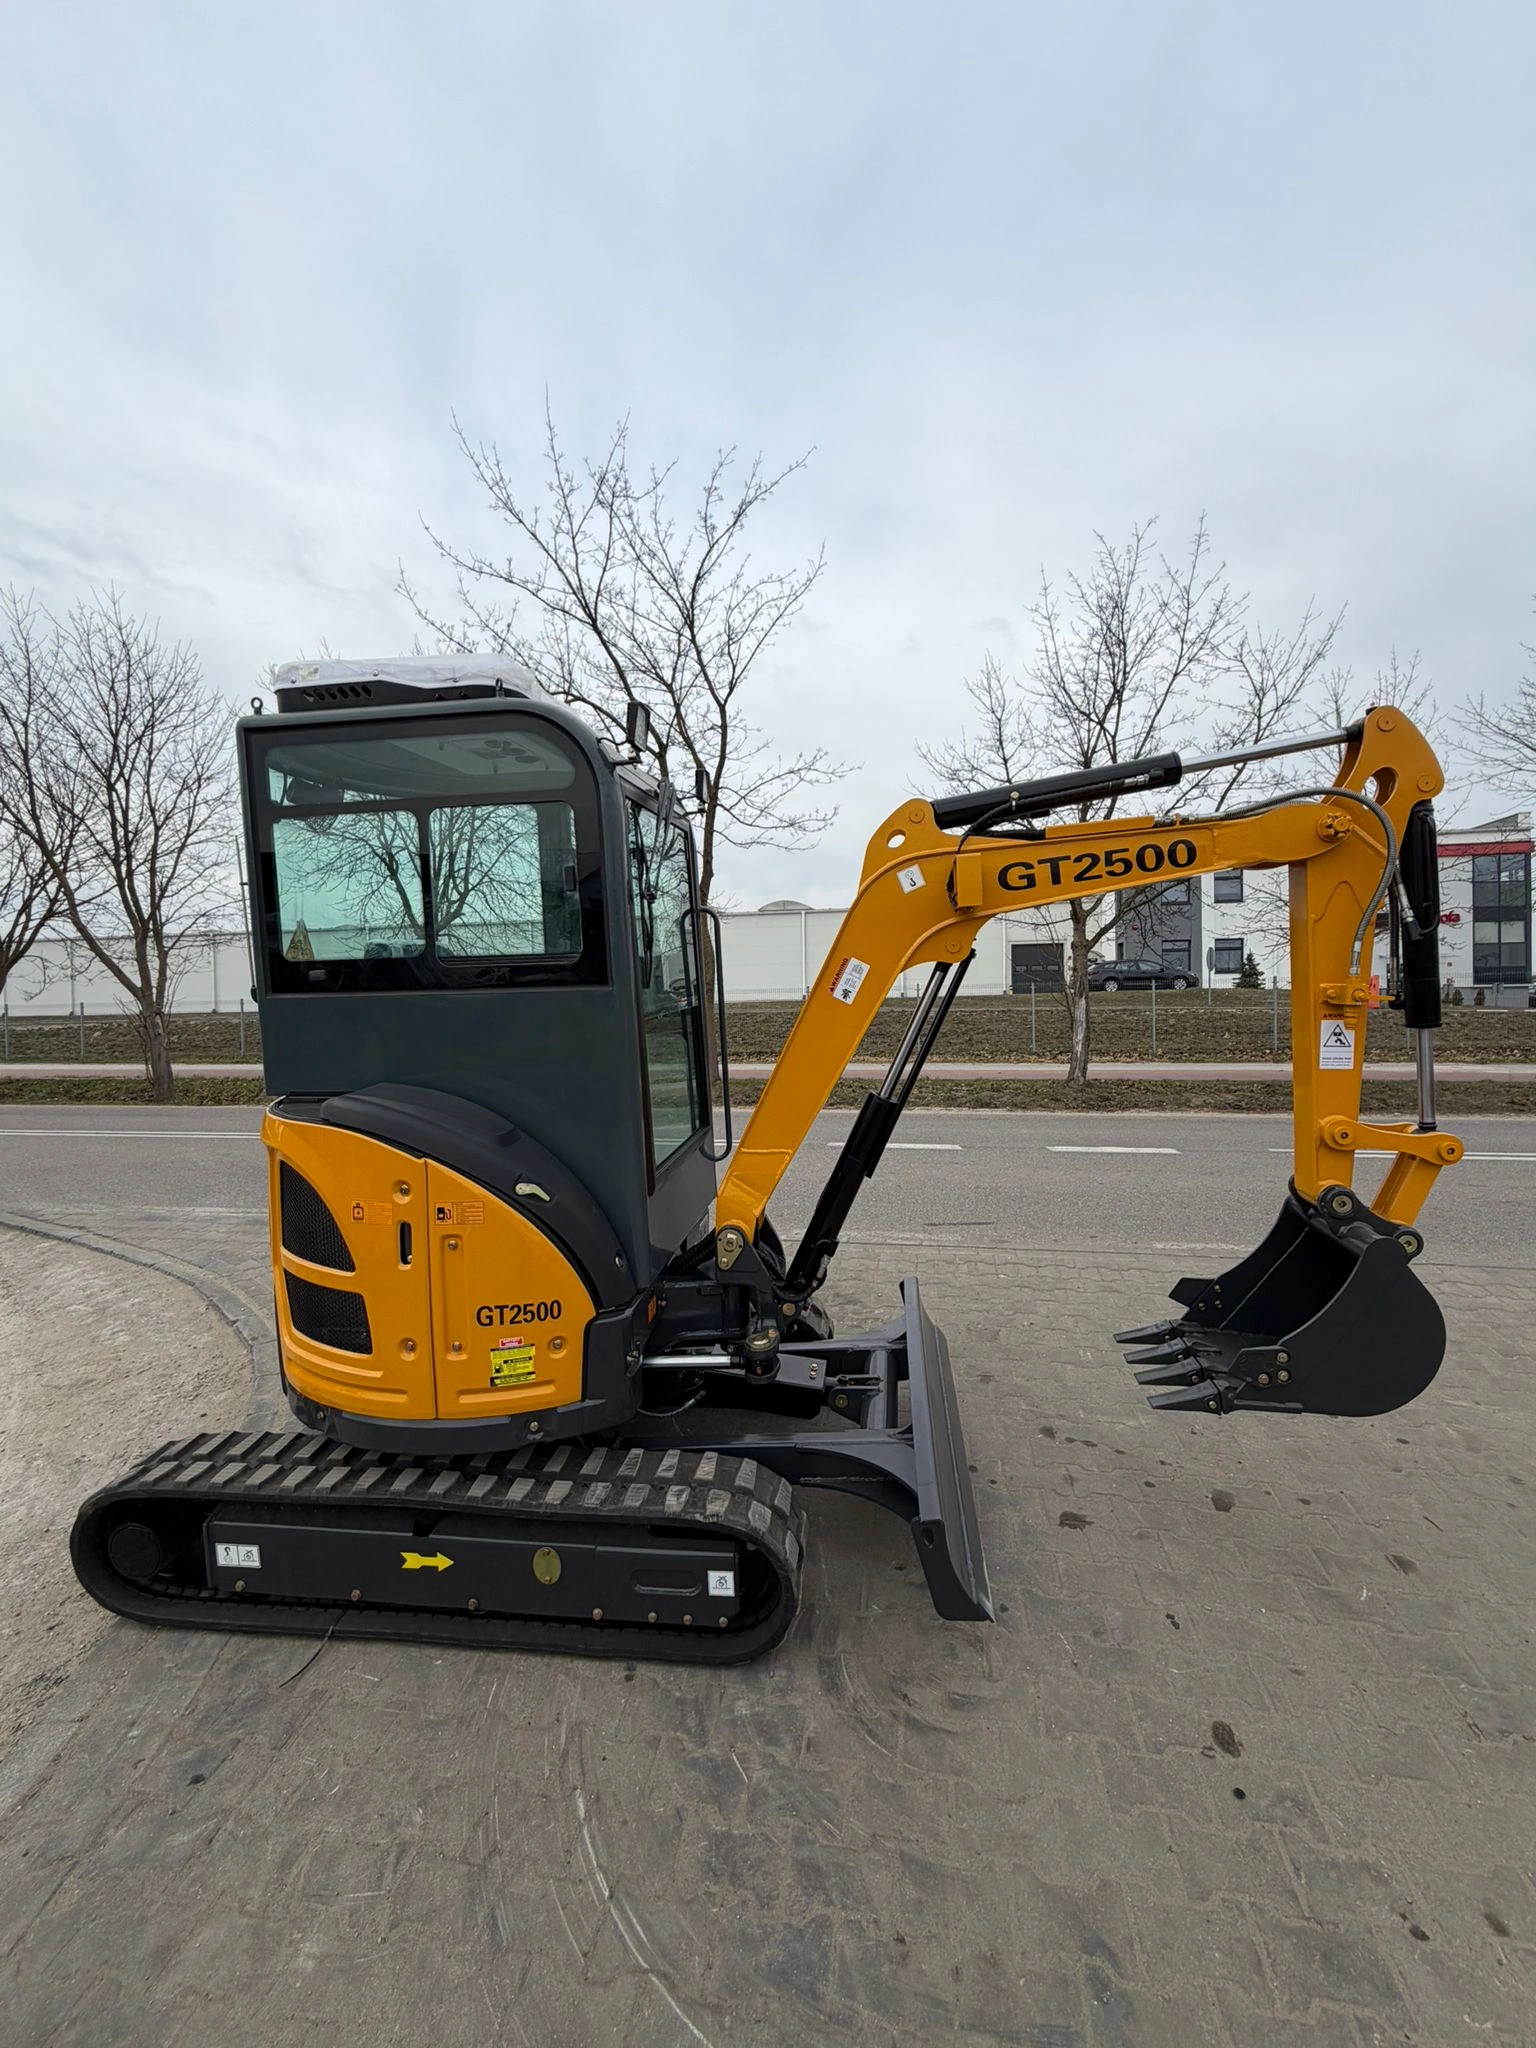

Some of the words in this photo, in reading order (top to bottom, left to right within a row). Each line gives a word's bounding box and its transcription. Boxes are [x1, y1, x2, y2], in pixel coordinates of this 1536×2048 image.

[997, 839, 1198, 892] GT2500
[1440, 911, 1460, 923] ofa
[831, 957, 849, 987] WARNING
[476, 1299, 562, 1327] GT2500
